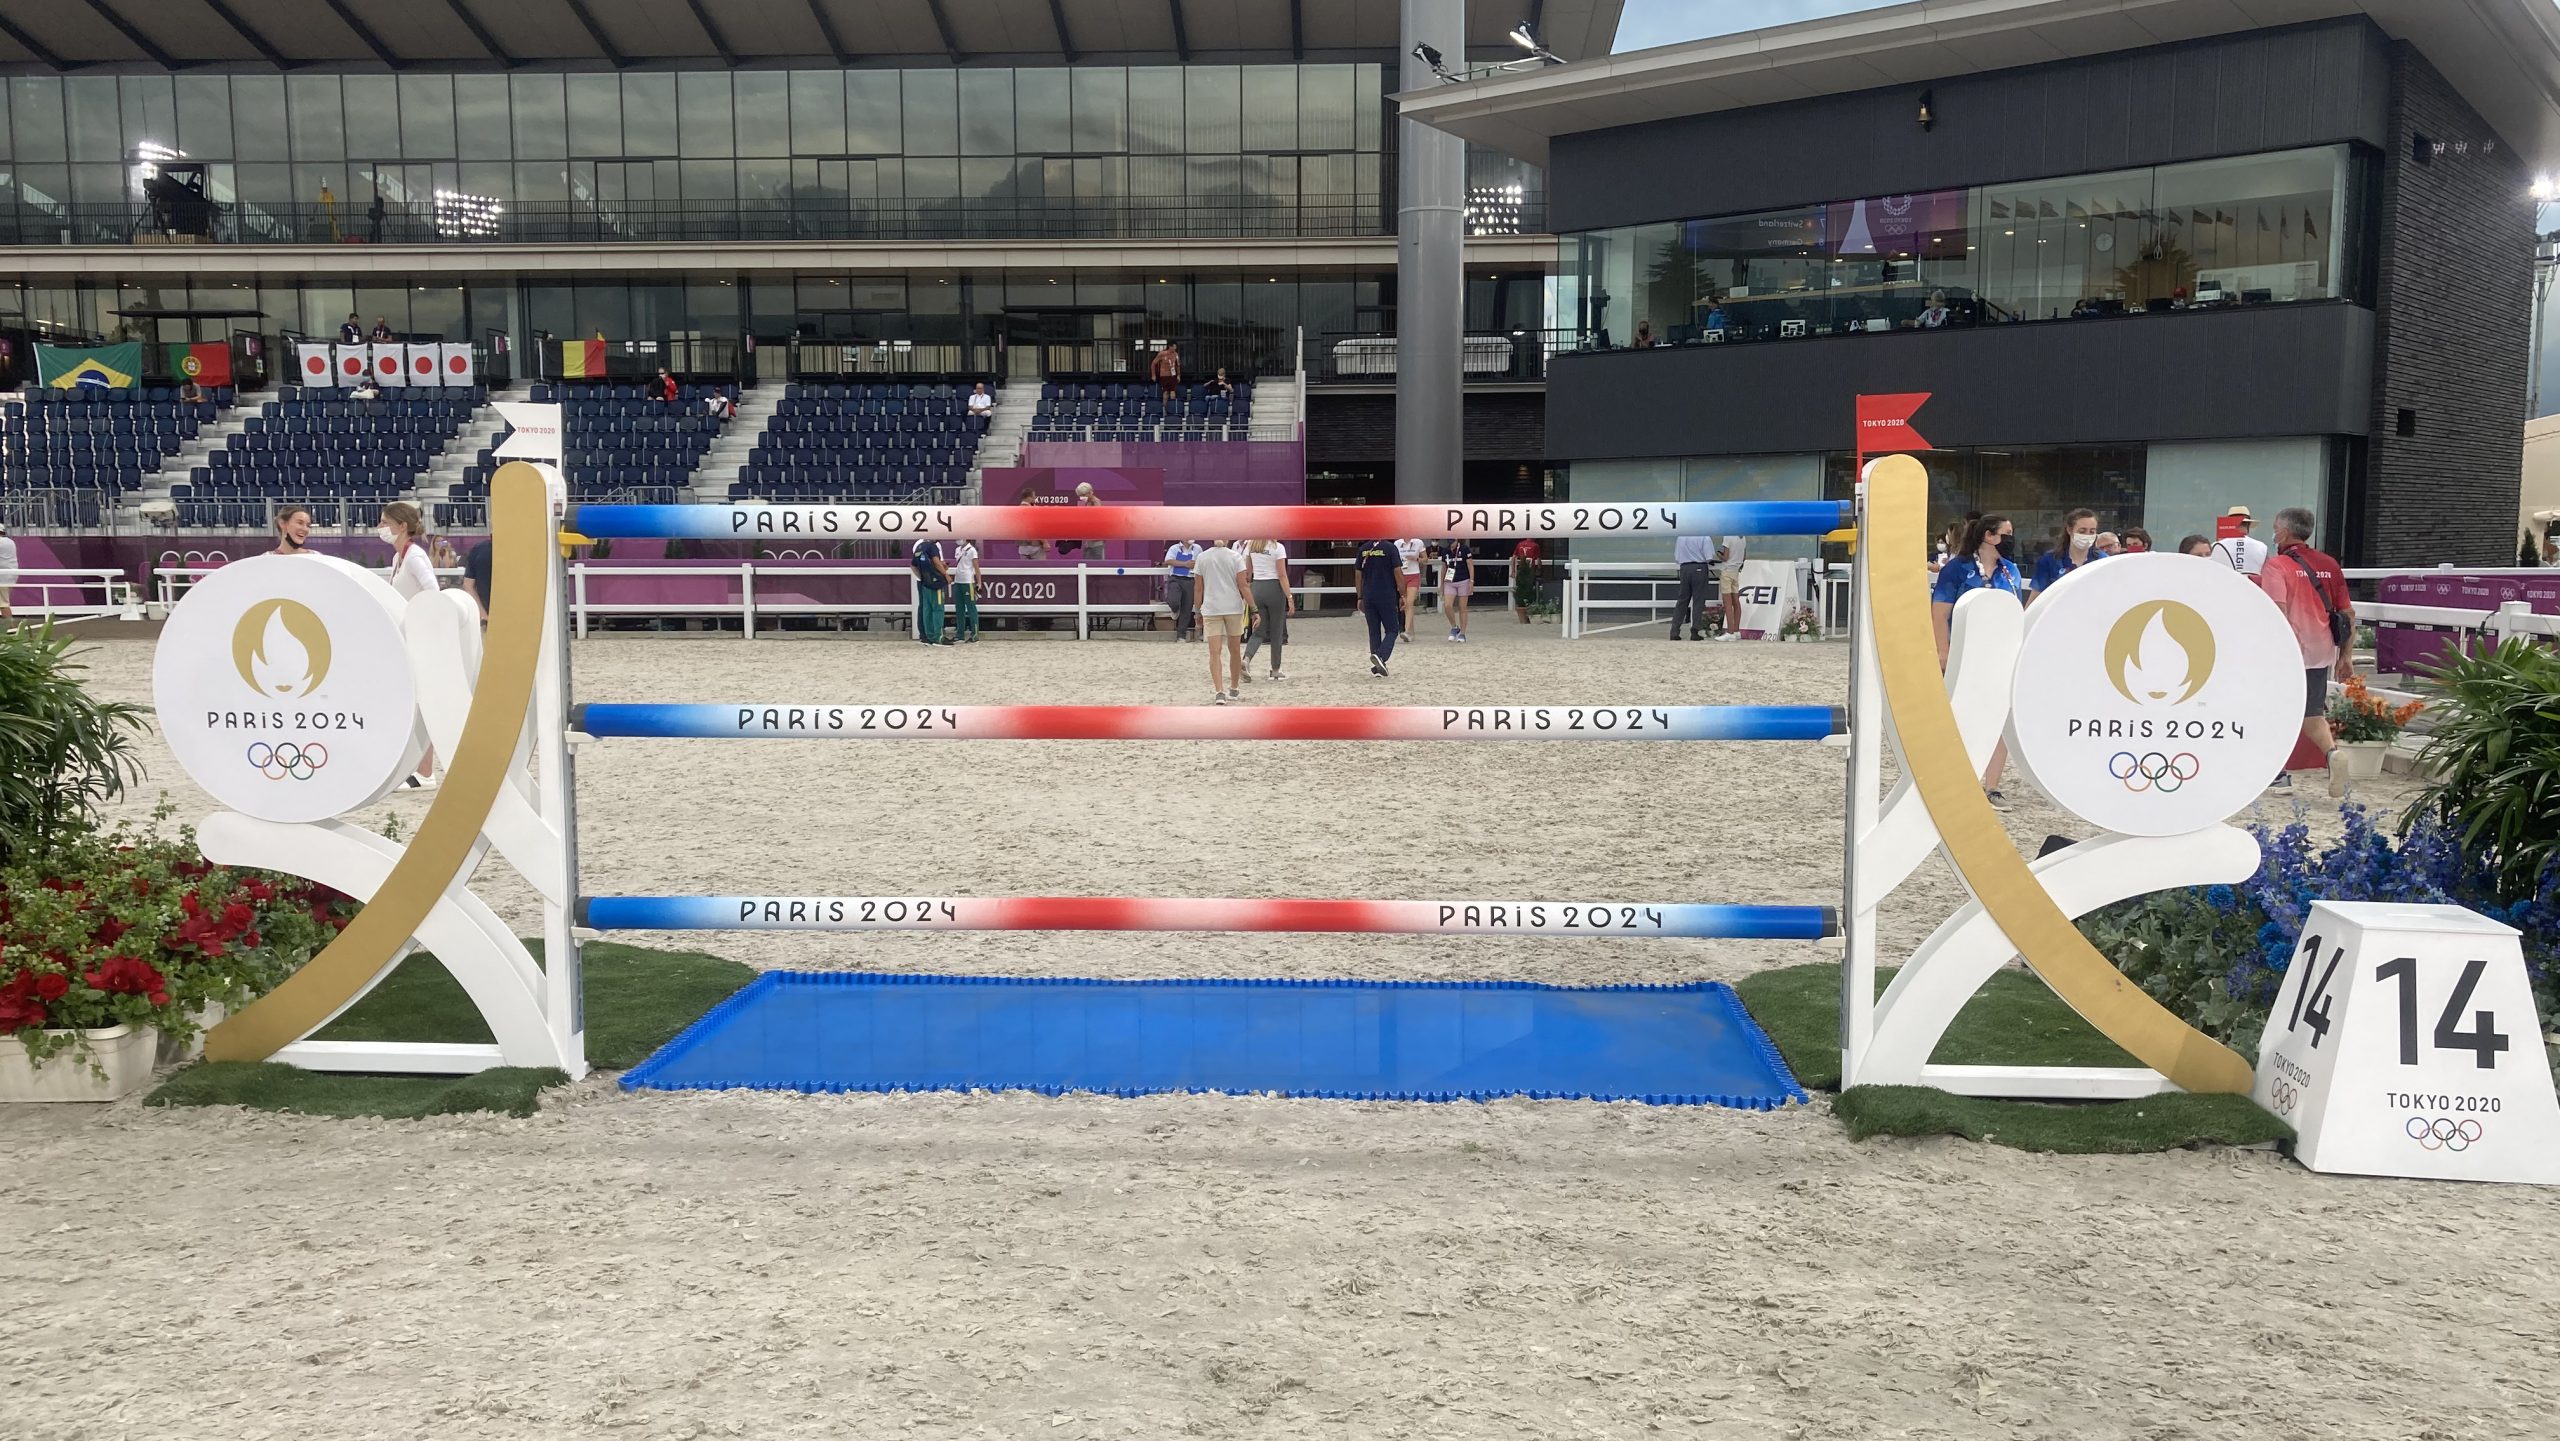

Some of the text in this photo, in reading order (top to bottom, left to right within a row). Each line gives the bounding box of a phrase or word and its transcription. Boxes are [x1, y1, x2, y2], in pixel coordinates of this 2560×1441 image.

[517, 426, 538, 434] TOKYO
[1862, 418, 1905, 427] TOKYO 2020
[855, 510, 953, 533] 2024
[1573, 507, 1677, 531] 2024
[1010, 582, 1056, 599] 2020
[1738, 586, 1778, 605] FEI
[294, 712, 365, 730] 2024
[860, 708, 956, 730] 2024
[1568, 709, 1668, 730] 2024
[2166, 720, 2244, 739] 2024
[860, 901, 956, 922] 2024
[1563, 906, 1662, 929] 2024
[2287, 934, 2344, 1049] 14
[2376, 957, 2509, 1069] 14
[2273, 1052, 2311, 1088] TOKYO 2020
[2387, 1092, 2501, 1113] TOKYO 2020
